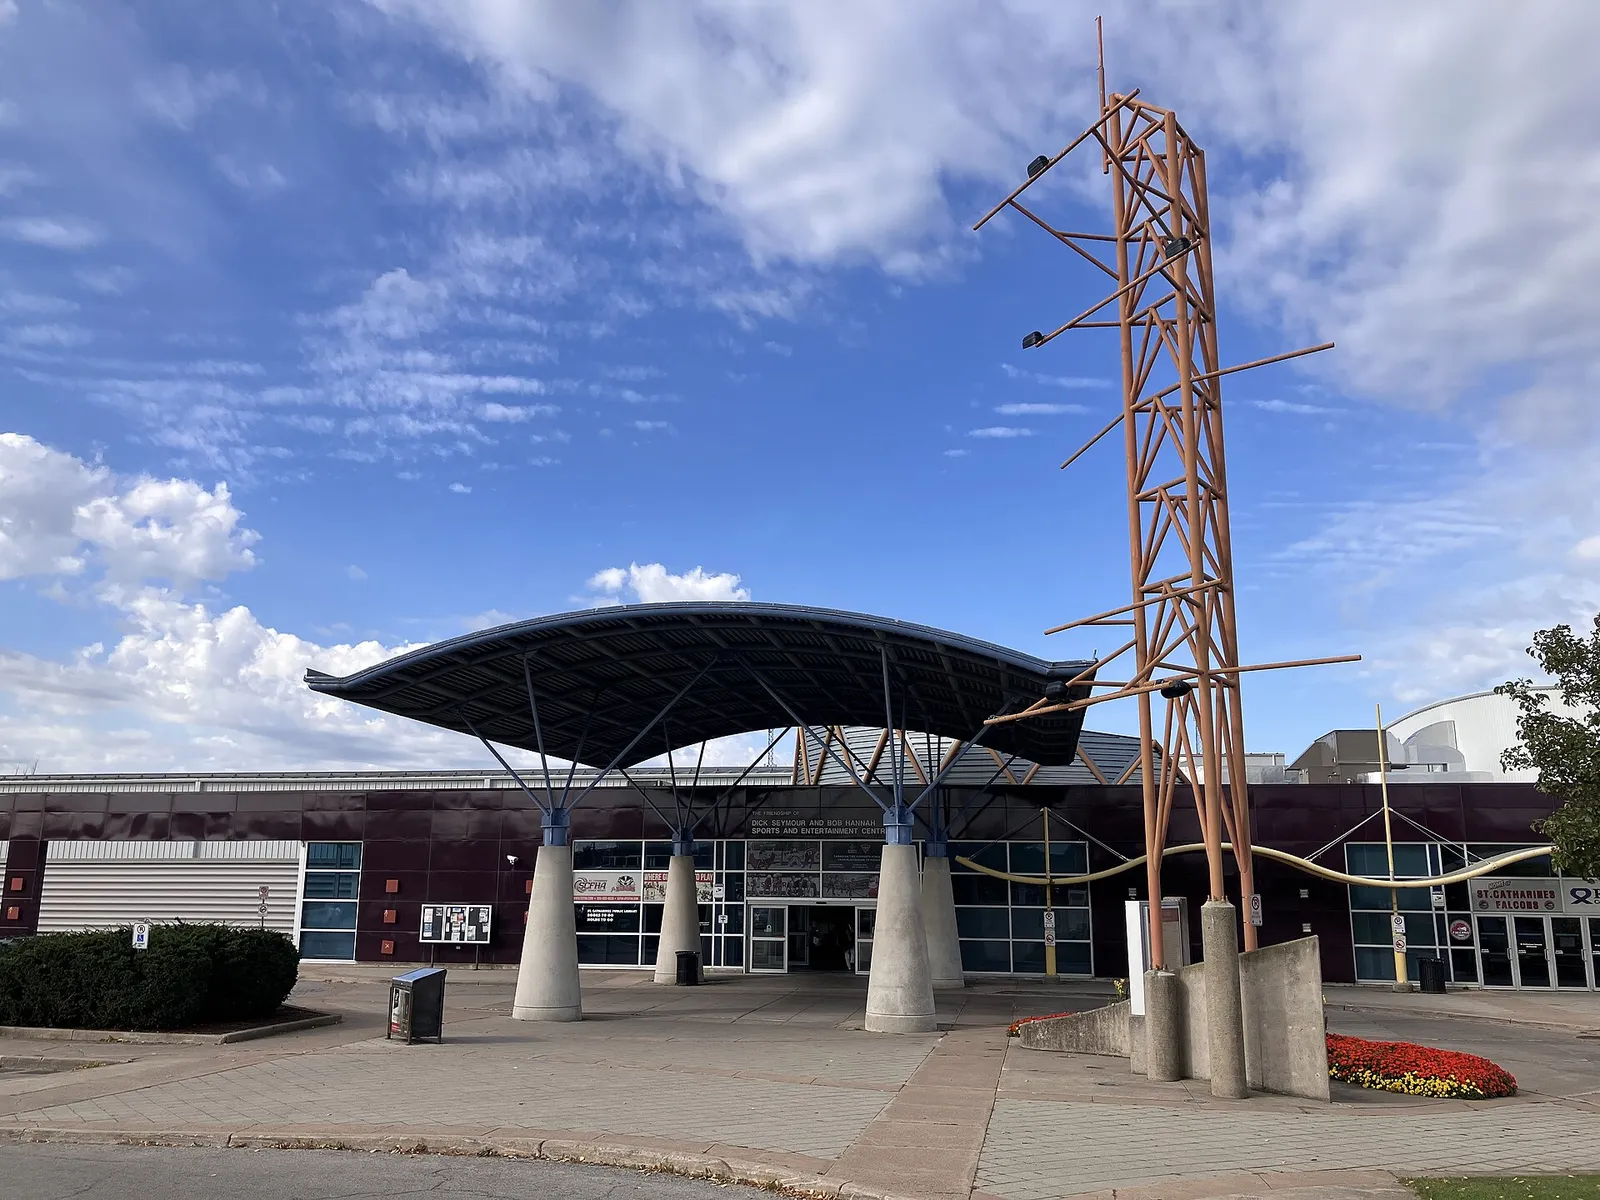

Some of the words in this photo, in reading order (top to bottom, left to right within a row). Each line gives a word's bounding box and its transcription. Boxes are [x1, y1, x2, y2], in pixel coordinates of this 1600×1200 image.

[751, 819, 768, 827] DICK
[771, 819, 806, 827] SEYMOUR
[809, 819, 825, 827] AND
[827, 819, 843, 827] BOB
[845, 819, 876, 827] HANNAH
[751, 827, 780, 835] SPORTS
[782, 827, 799, 835] AND
[800, 827, 858, 835] ENTERTAINMENT
[861, 827, 885, 835] CENTR
[700, 873, 714, 881] PLAY
[1495, 900, 1540, 910] FALCONS
